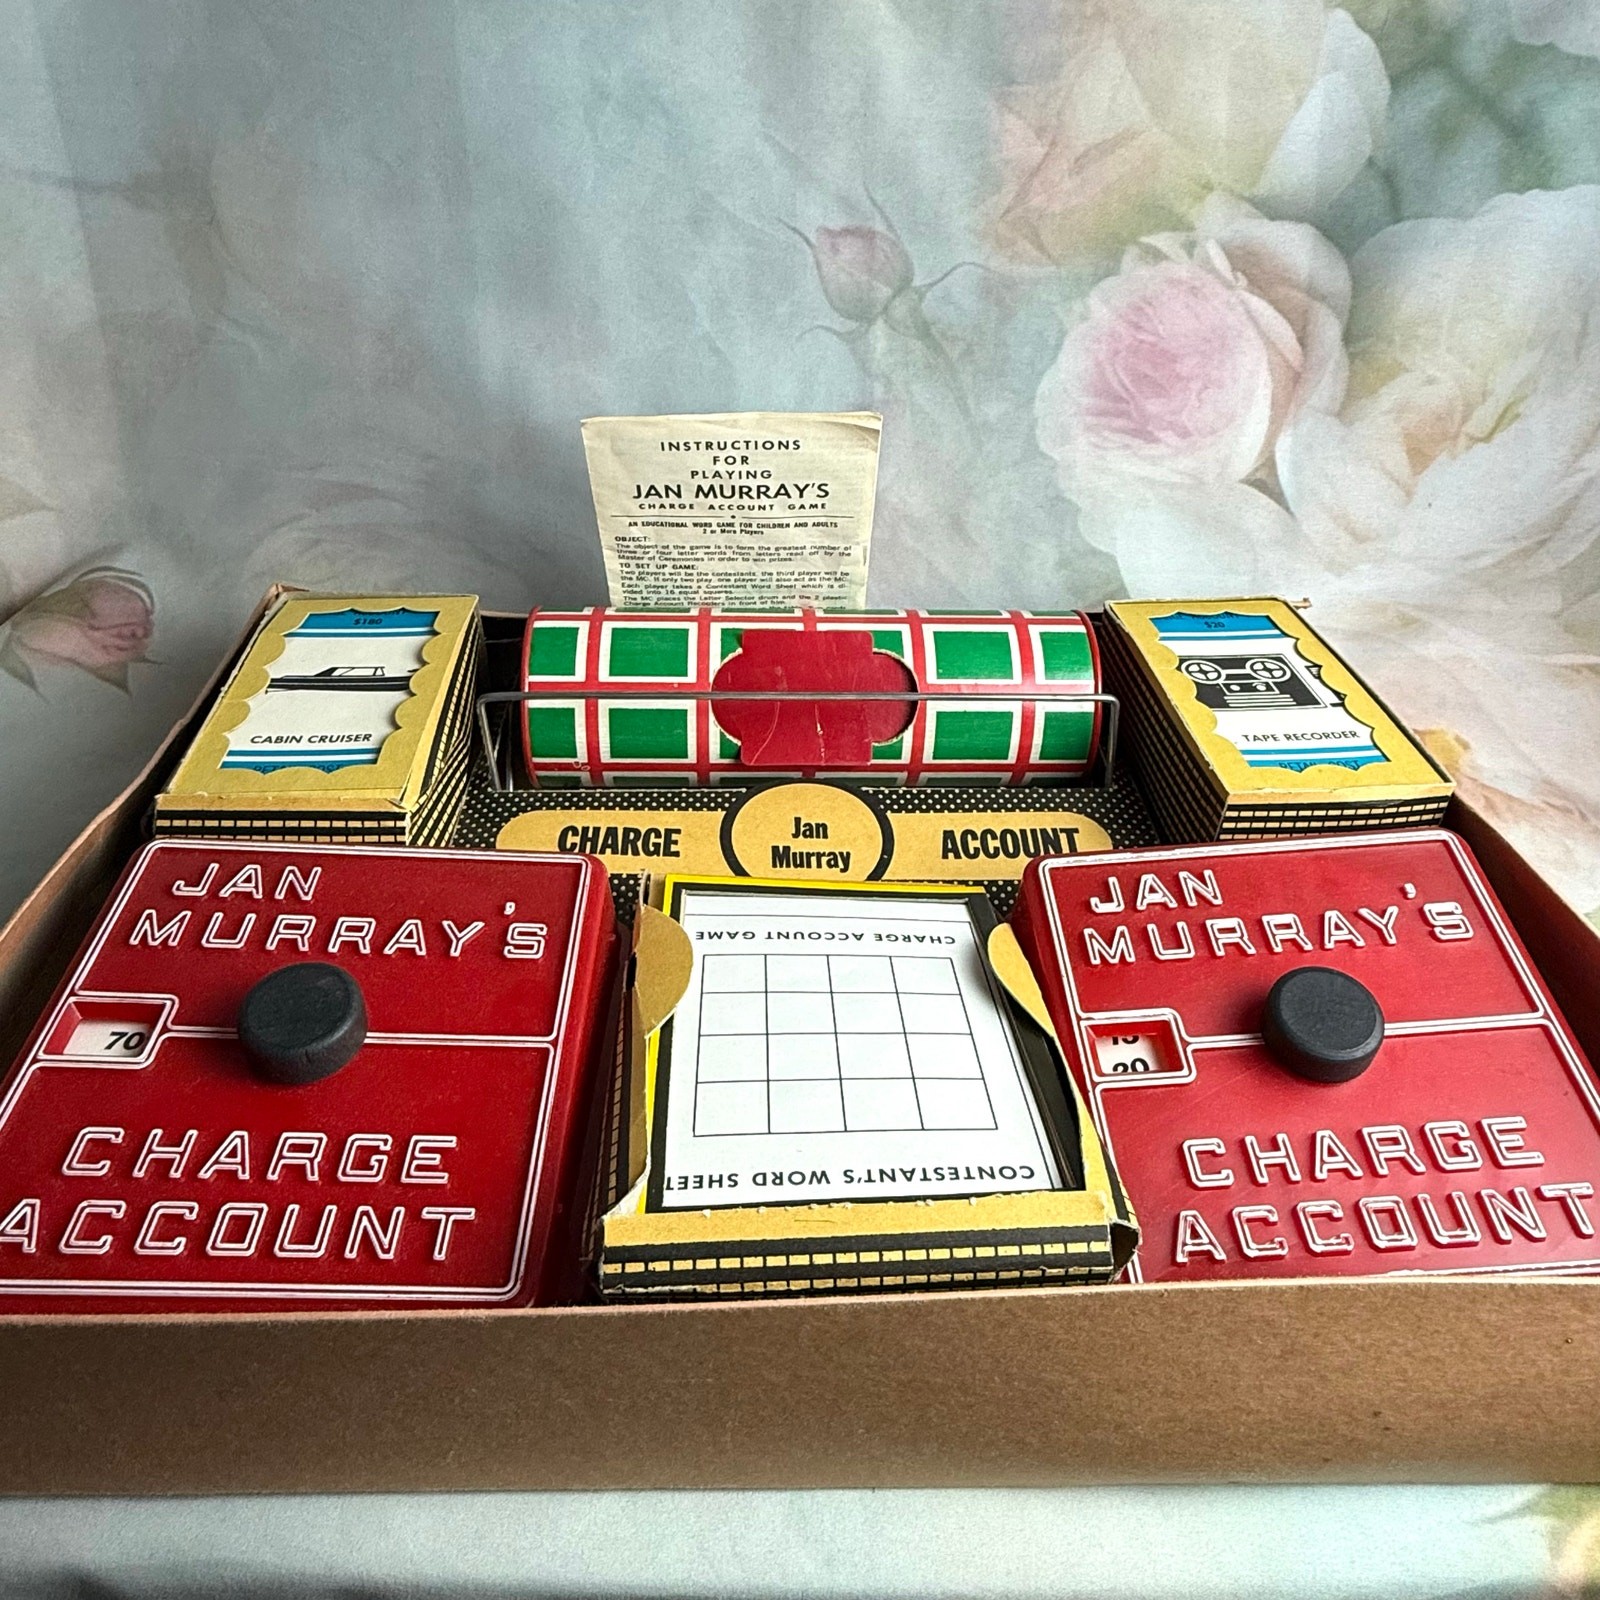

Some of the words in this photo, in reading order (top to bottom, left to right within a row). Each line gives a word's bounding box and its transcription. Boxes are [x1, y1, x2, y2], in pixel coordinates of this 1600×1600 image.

[661, 440, 801, 452] INSTRUCTIONS
[713, 456, 750, 466] FOR
[691, 470, 773, 480] PLAYING
[632, 484, 682, 499] JAN
[695, 483, 830, 500] MURRAY'S
[353, 618, 383, 626] $180
[1204, 621, 1226, 629] $20
[250, 735, 303, 744] CABIN
[308, 734, 372, 744] CRUISER
[1242, 734, 1281, 742] TAPE
[1283, 730, 1360, 741] RECORDER
[791, 816, 829, 840] Jan
[558, 826, 681, 858] CHARGE
[942, 827, 1080, 860] ACCOUNT
[771, 845, 851, 874] Murray
[172, 863, 322, 900] JAN
[1090, 868, 1224, 914] JAN
[128, 901, 548, 959] MURRAY'S
[1082, 883, 1475, 966] MURRAY'S
[696, 930, 756, 940] GAME
[765, 930, 864, 944] ACCOUNT
[874, 932, 956, 946] CHARGE
[104, 1030, 146, 1050] 70
[61, 1126, 458, 1185] CHARGE
[1181, 1115, 1546, 1189] CHARGE
[666, 1172, 740, 1192] SHEET
[752, 1169, 831, 1187] WORD
[844, 1165, 1035, 1184] CONTESTANT'S
[0, 1198, 476, 1261] ACCOUNT
[1176, 1181, 1595, 1264] ACCOUNT
